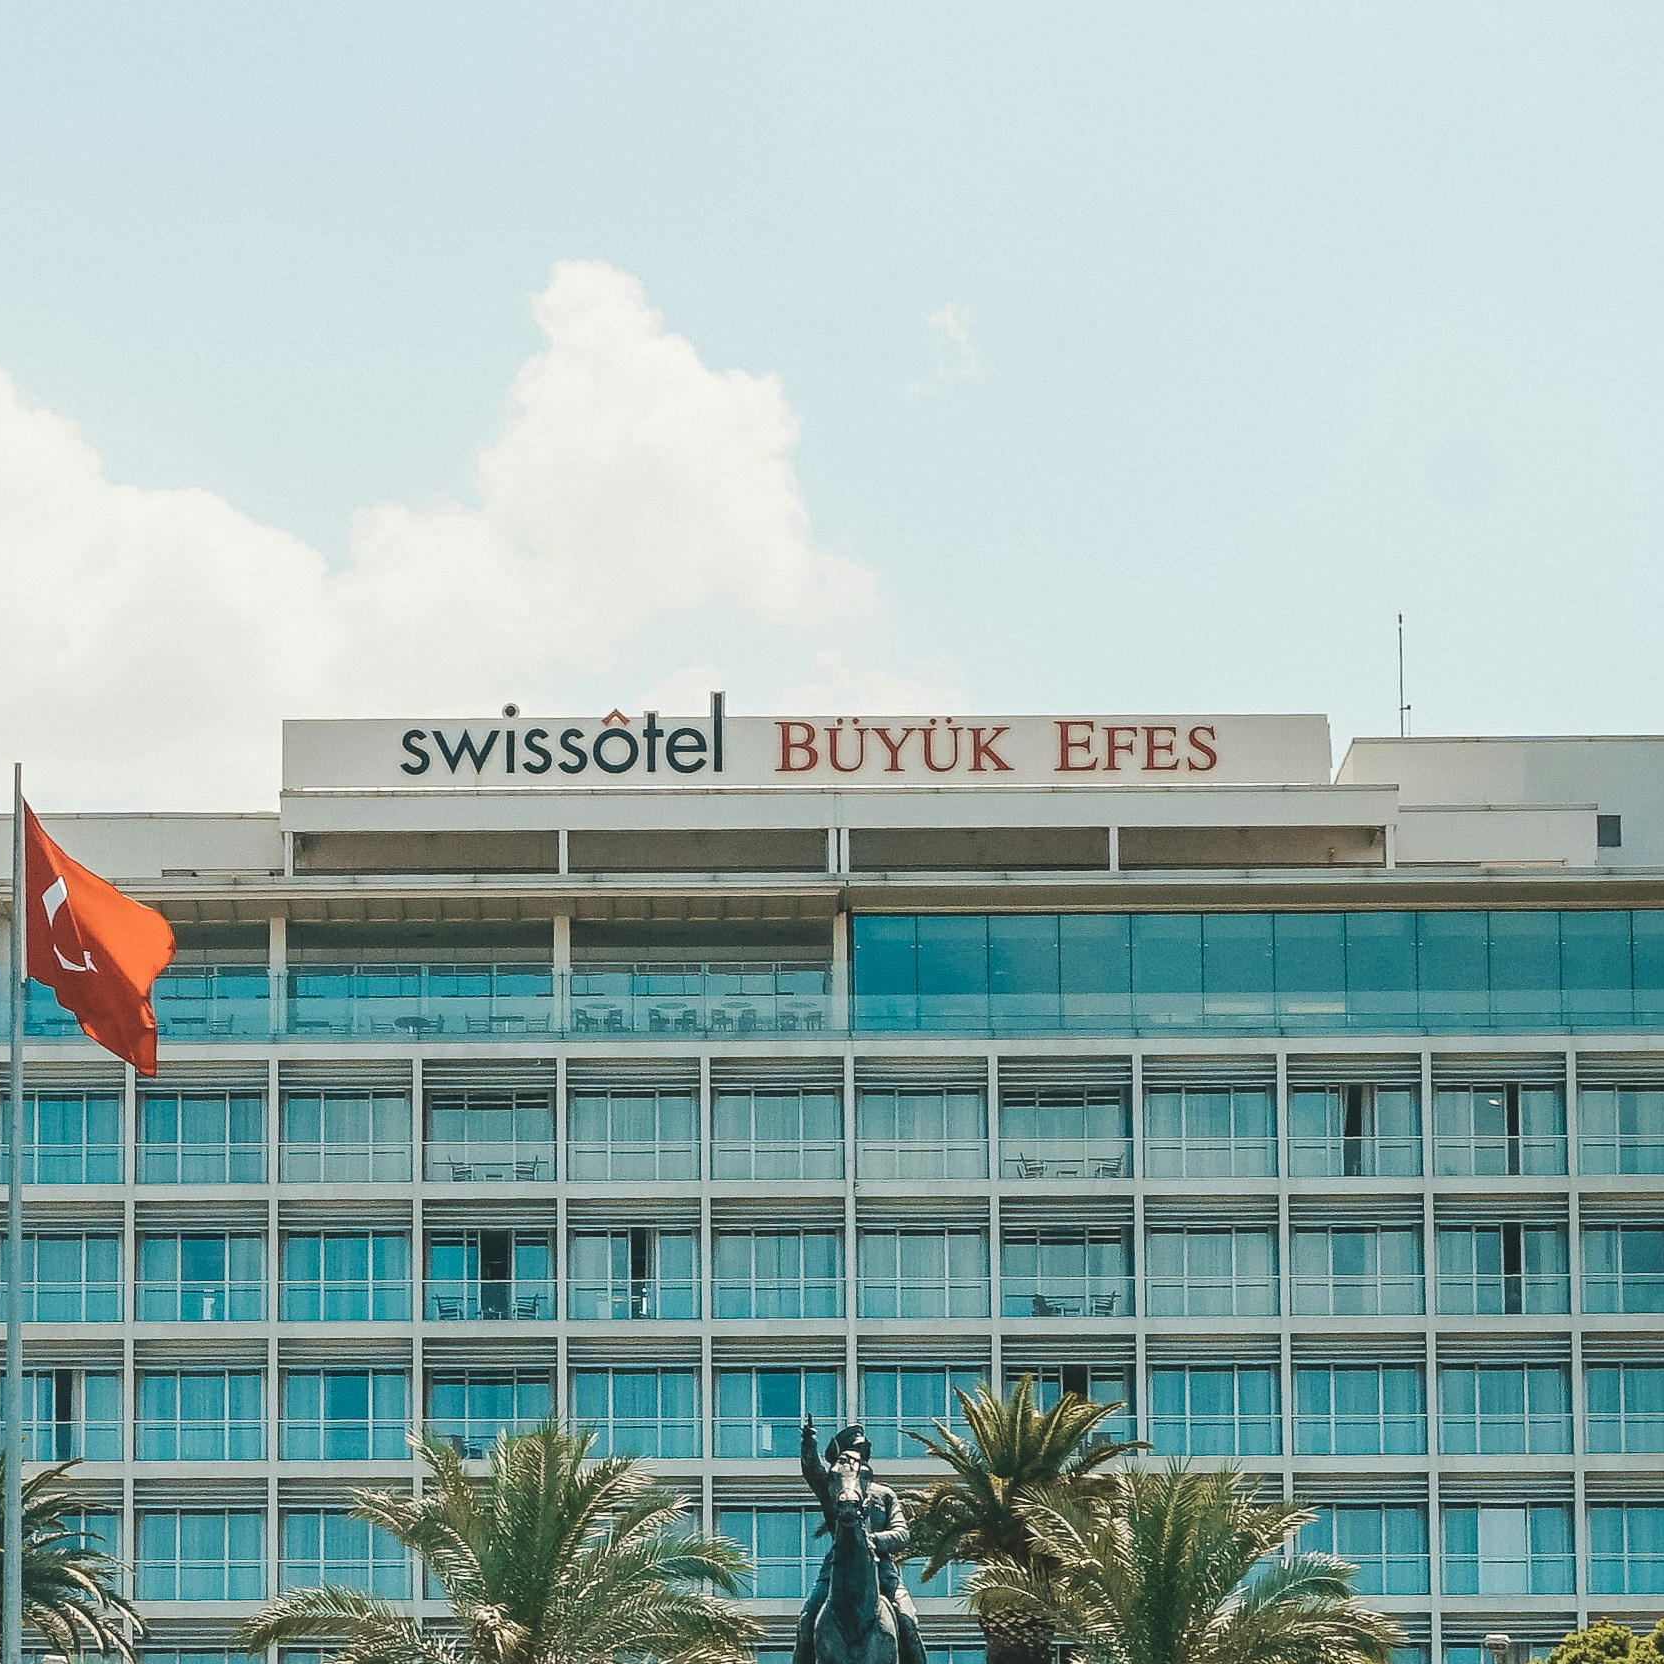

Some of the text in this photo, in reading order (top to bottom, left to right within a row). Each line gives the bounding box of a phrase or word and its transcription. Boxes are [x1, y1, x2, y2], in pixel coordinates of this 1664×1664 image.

[400, 693, 1218, 775] swissôtel BÜYÜK EFES
